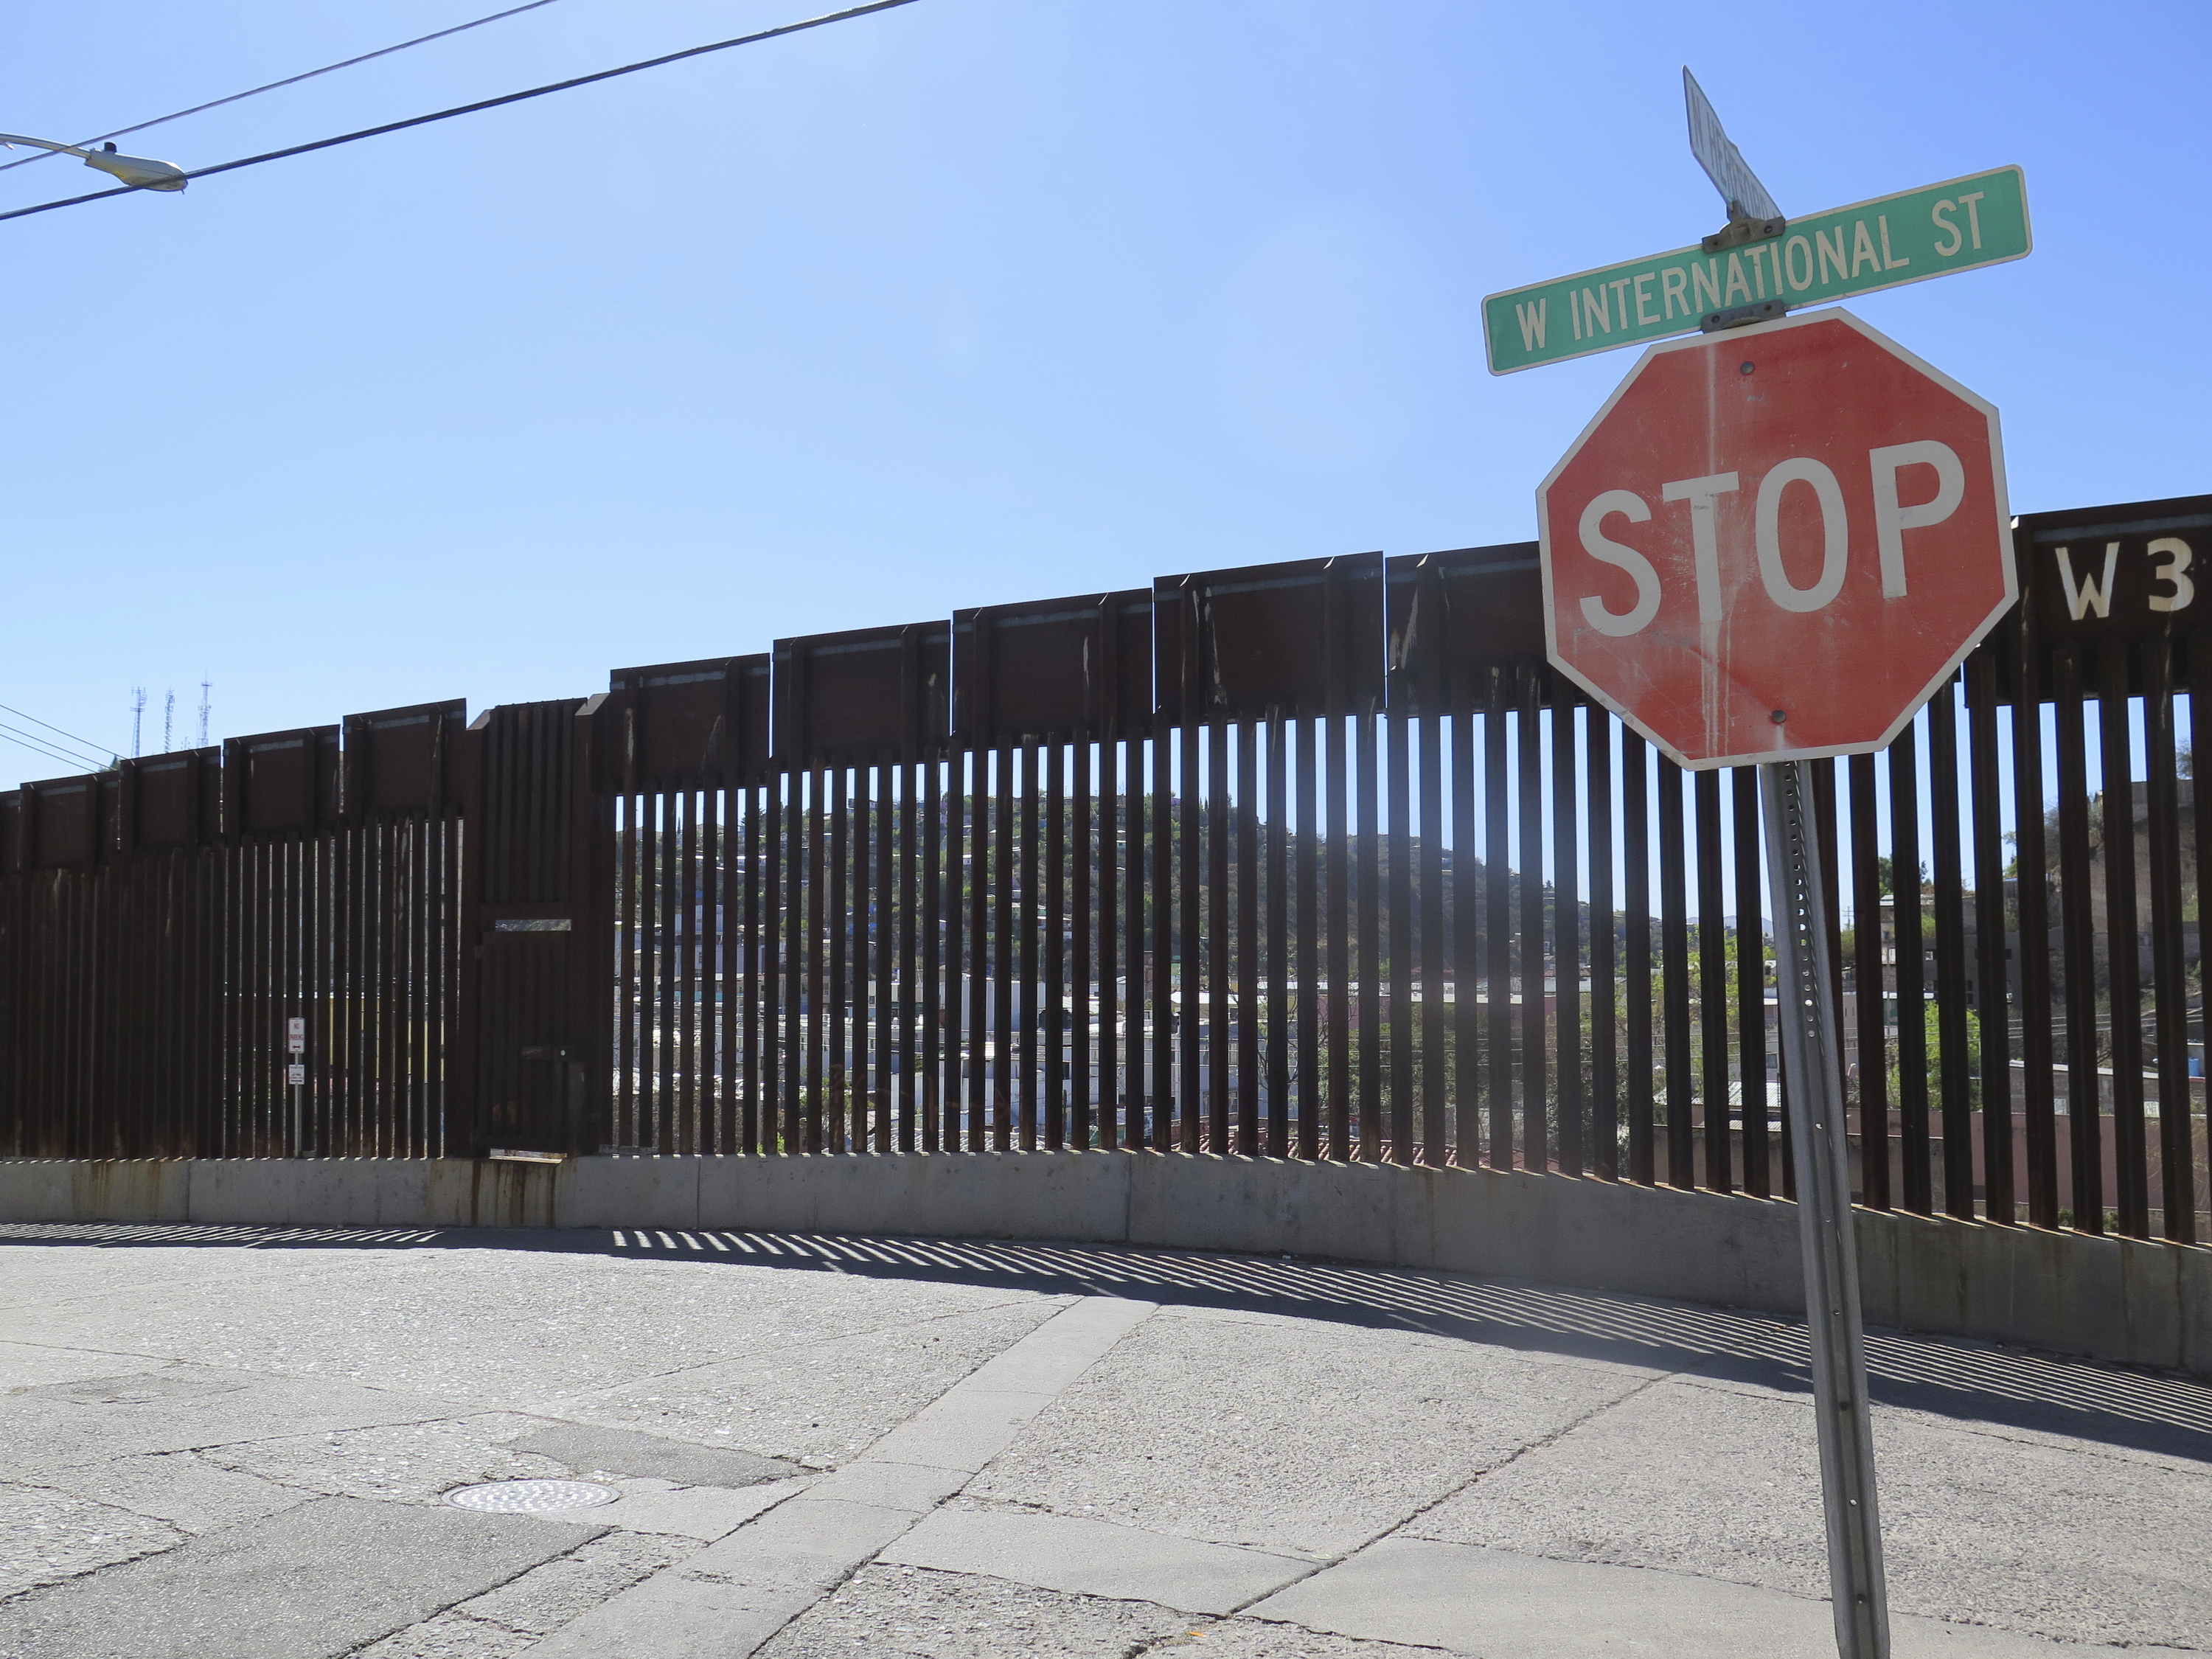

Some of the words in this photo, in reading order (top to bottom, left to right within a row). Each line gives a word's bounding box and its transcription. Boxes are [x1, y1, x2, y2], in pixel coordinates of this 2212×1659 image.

[1516, 298, 1547, 352] W
[1569, 215, 1910, 341] INTERNATIONAL
[1931, 191, 1985, 257] ST
[1579, 439, 1965, 638] STOP
